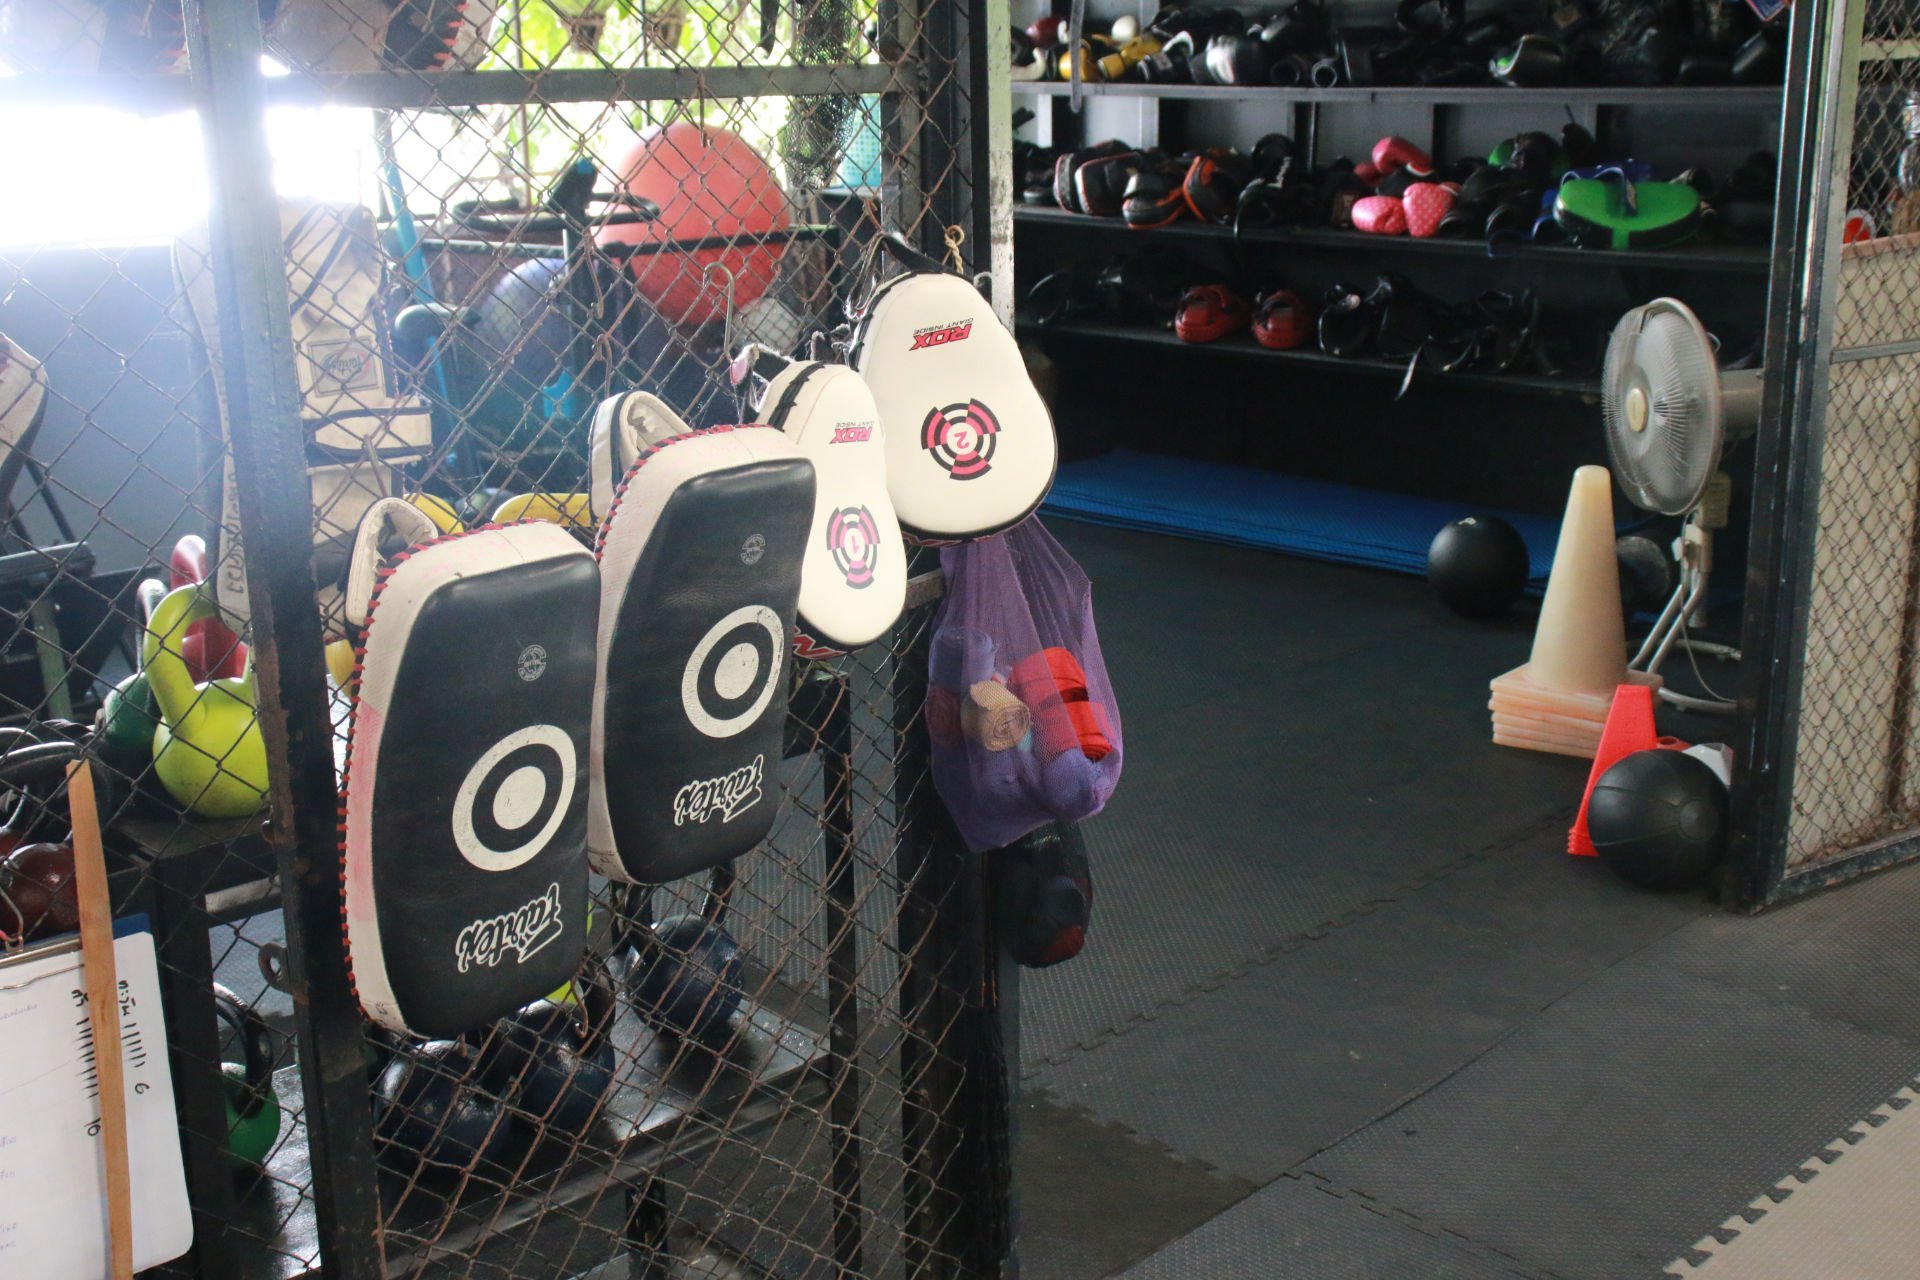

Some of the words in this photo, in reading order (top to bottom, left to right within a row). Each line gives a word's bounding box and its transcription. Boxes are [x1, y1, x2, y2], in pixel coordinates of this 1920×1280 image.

[954, 431, 970, 449] 2
[851, 535, 860, 554] 1
[674, 754, 764, 826] Fairtex
[455, 882, 563, 974] Fairtex
[134, 1082, 150, 1095] 6
